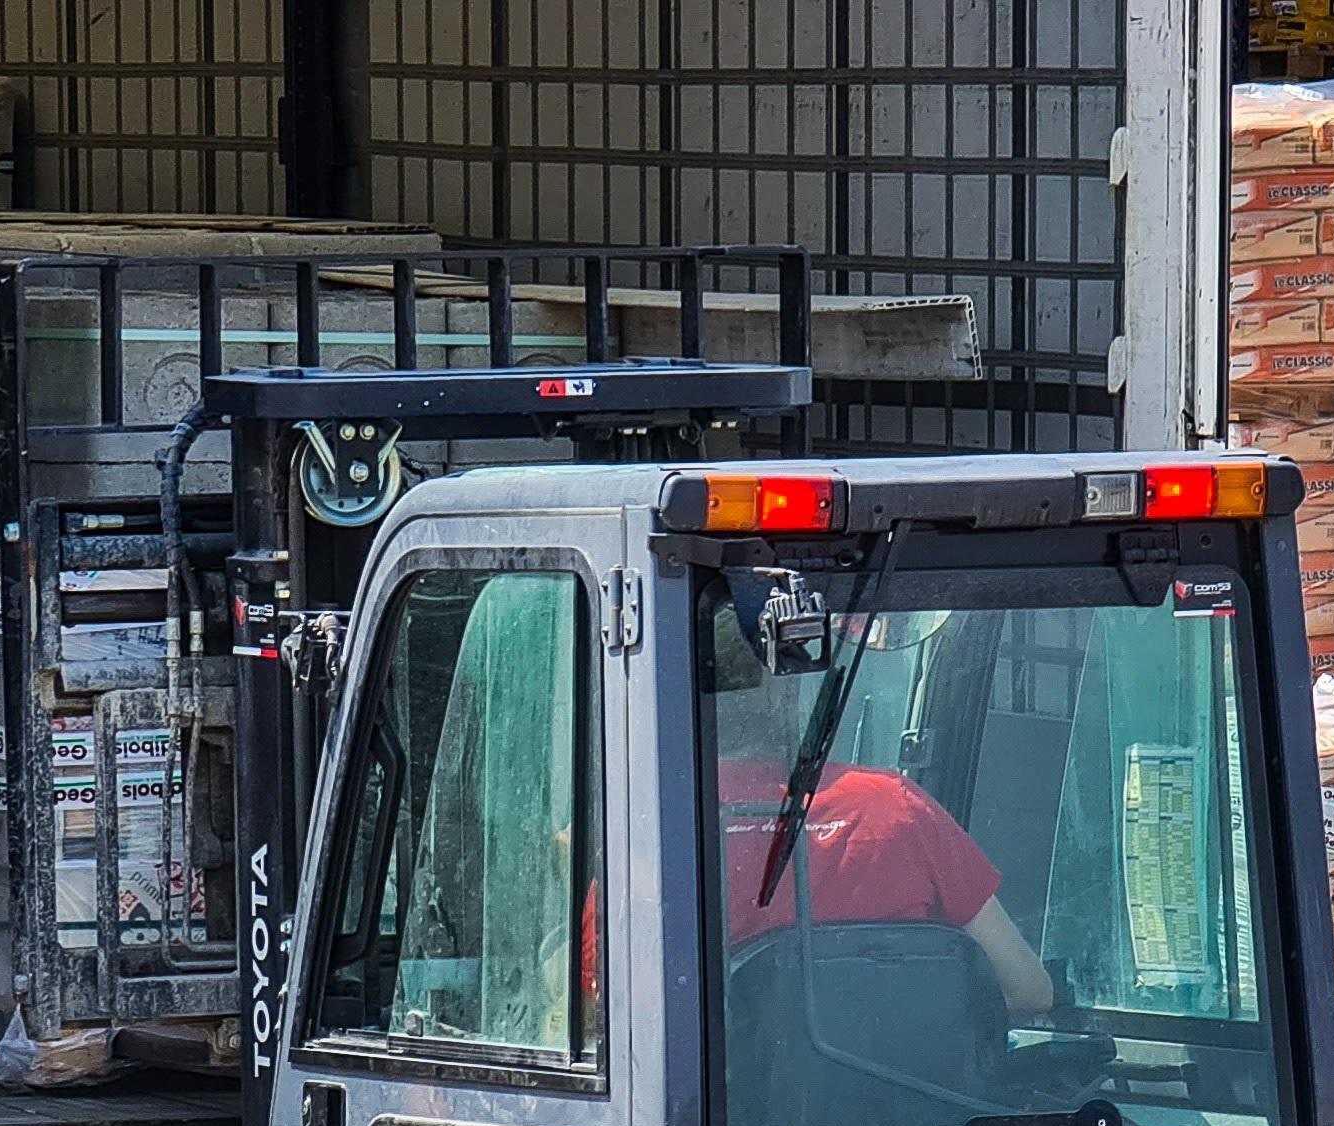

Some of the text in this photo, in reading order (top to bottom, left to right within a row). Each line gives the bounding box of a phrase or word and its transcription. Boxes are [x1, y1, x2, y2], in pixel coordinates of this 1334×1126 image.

[1281, 185, 1329, 197] CLASSIC
[1286, 273, 1334, 287] CLASSIC
[1284, 355, 1333, 367] CLASSIC
[250, 843, 271, 1078] TOYOTA
